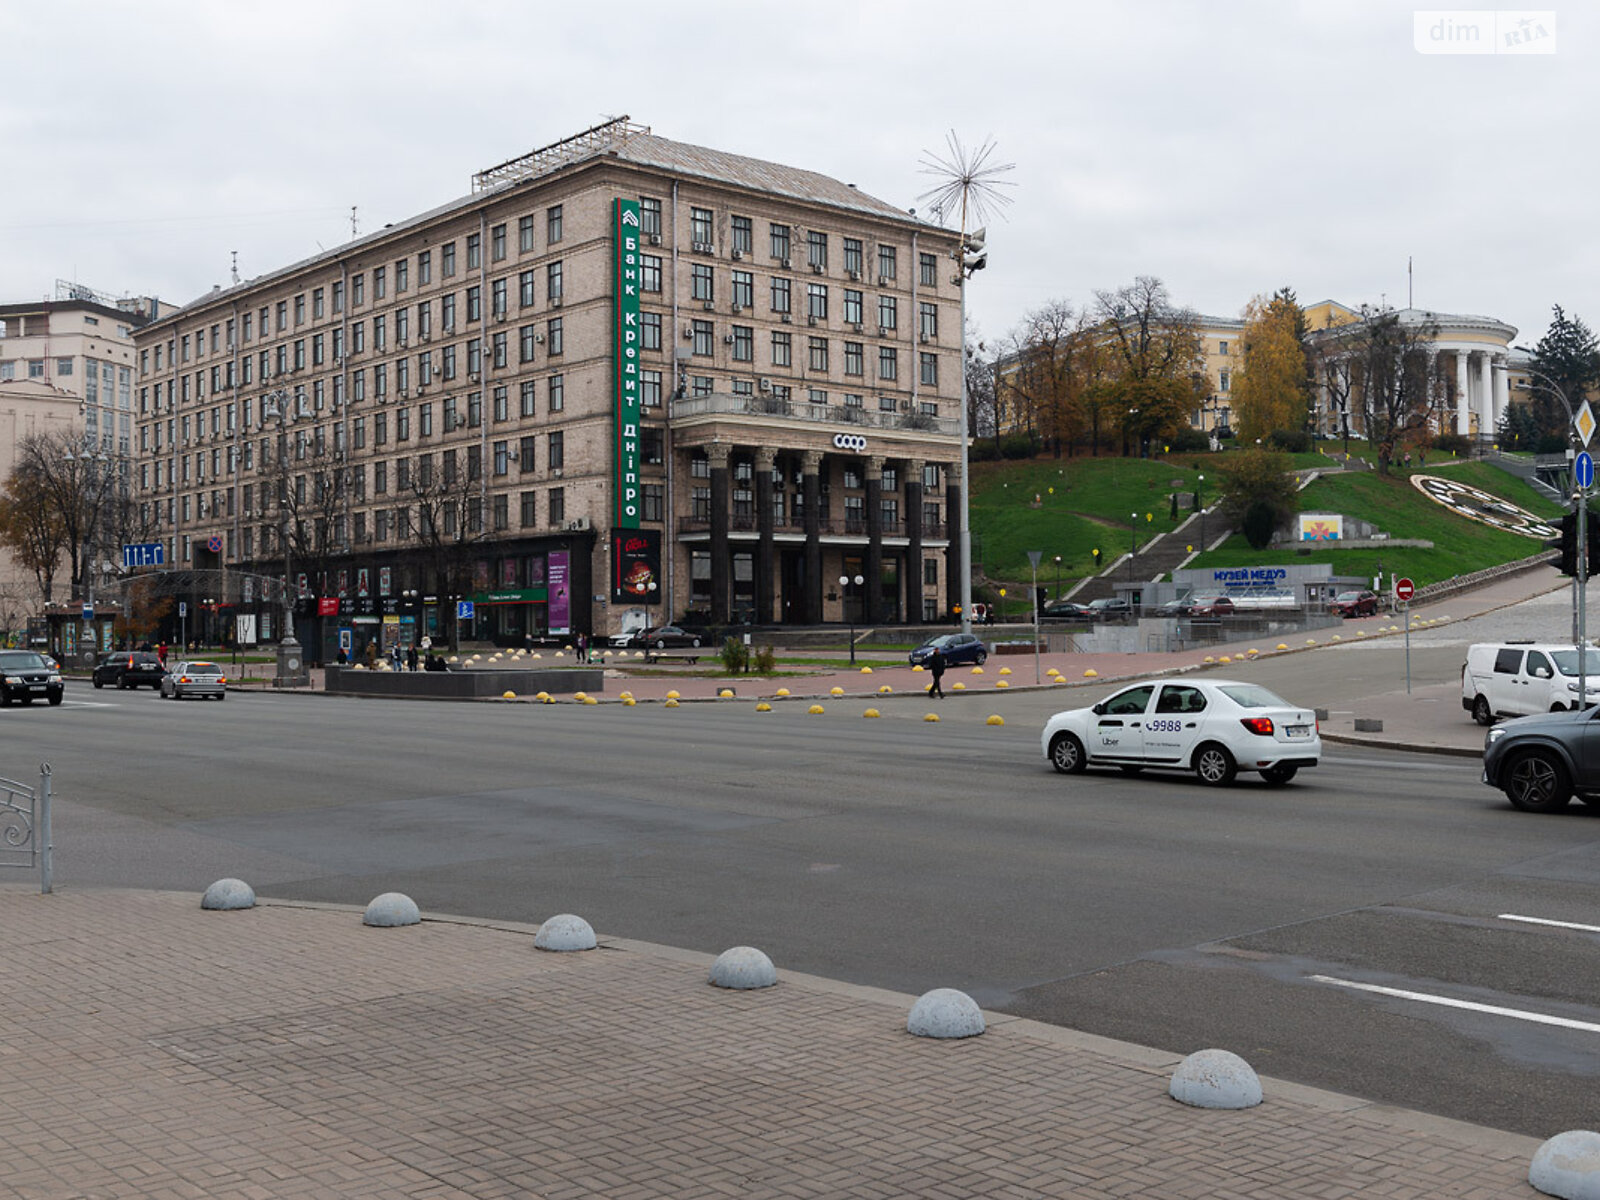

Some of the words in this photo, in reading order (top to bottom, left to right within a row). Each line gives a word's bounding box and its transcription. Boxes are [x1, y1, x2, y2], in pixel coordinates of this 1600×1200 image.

[625, 237, 637, 296] Банк
[625, 312, 637, 407] Кредит
[623, 424, 637, 517] Дніпро
[1214, 569, 1249, 581] МУЗЕЙ
[1250, 568, 1287, 581] МЕДУЗ
[1153, 720, 1181, 732] 9988
